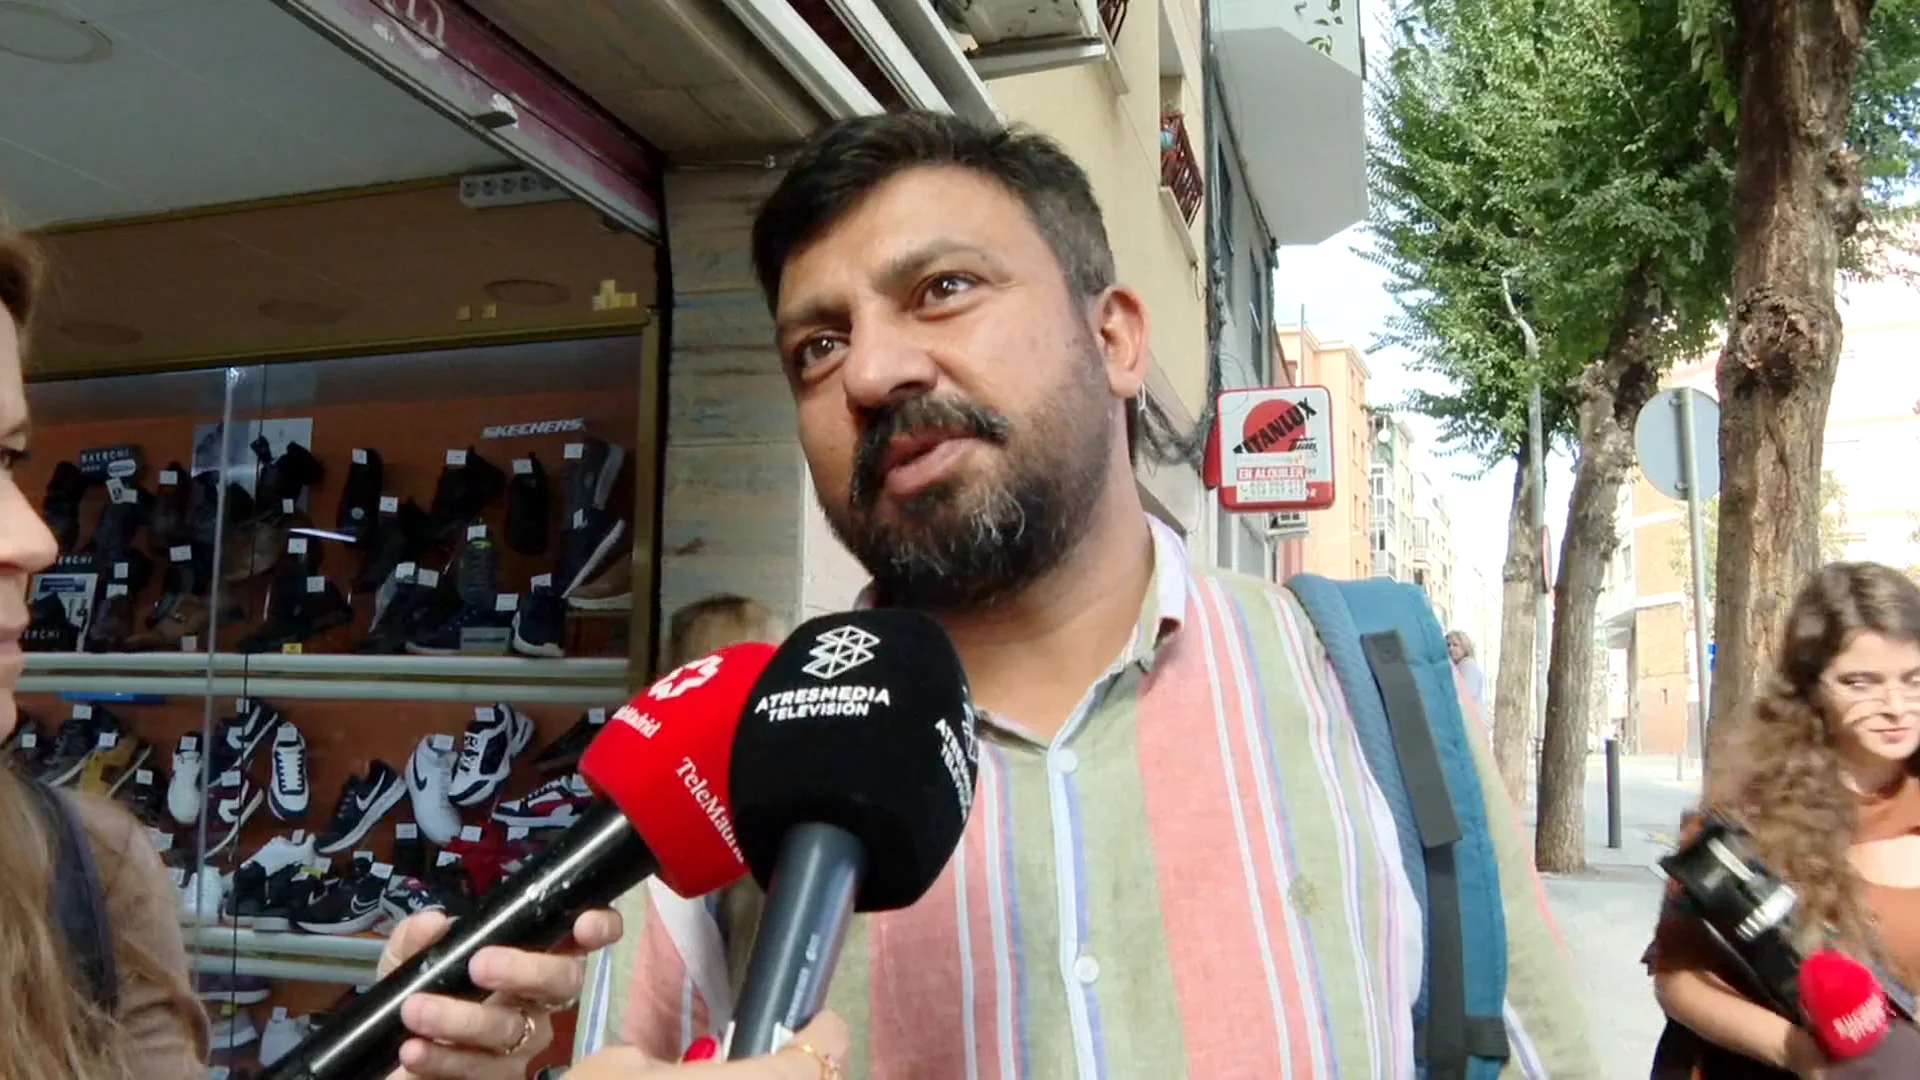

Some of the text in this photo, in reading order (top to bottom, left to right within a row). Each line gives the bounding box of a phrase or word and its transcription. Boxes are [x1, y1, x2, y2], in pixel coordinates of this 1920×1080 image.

[482, 417, 587, 439] SKECHERS
[1239, 468, 1254, 480] EN
[1255, 466, 1304, 480] ALQUILER
[754, 686, 891, 715] ATRESMEDIA
[768, 701, 870, 722] TELEVISIÓN
